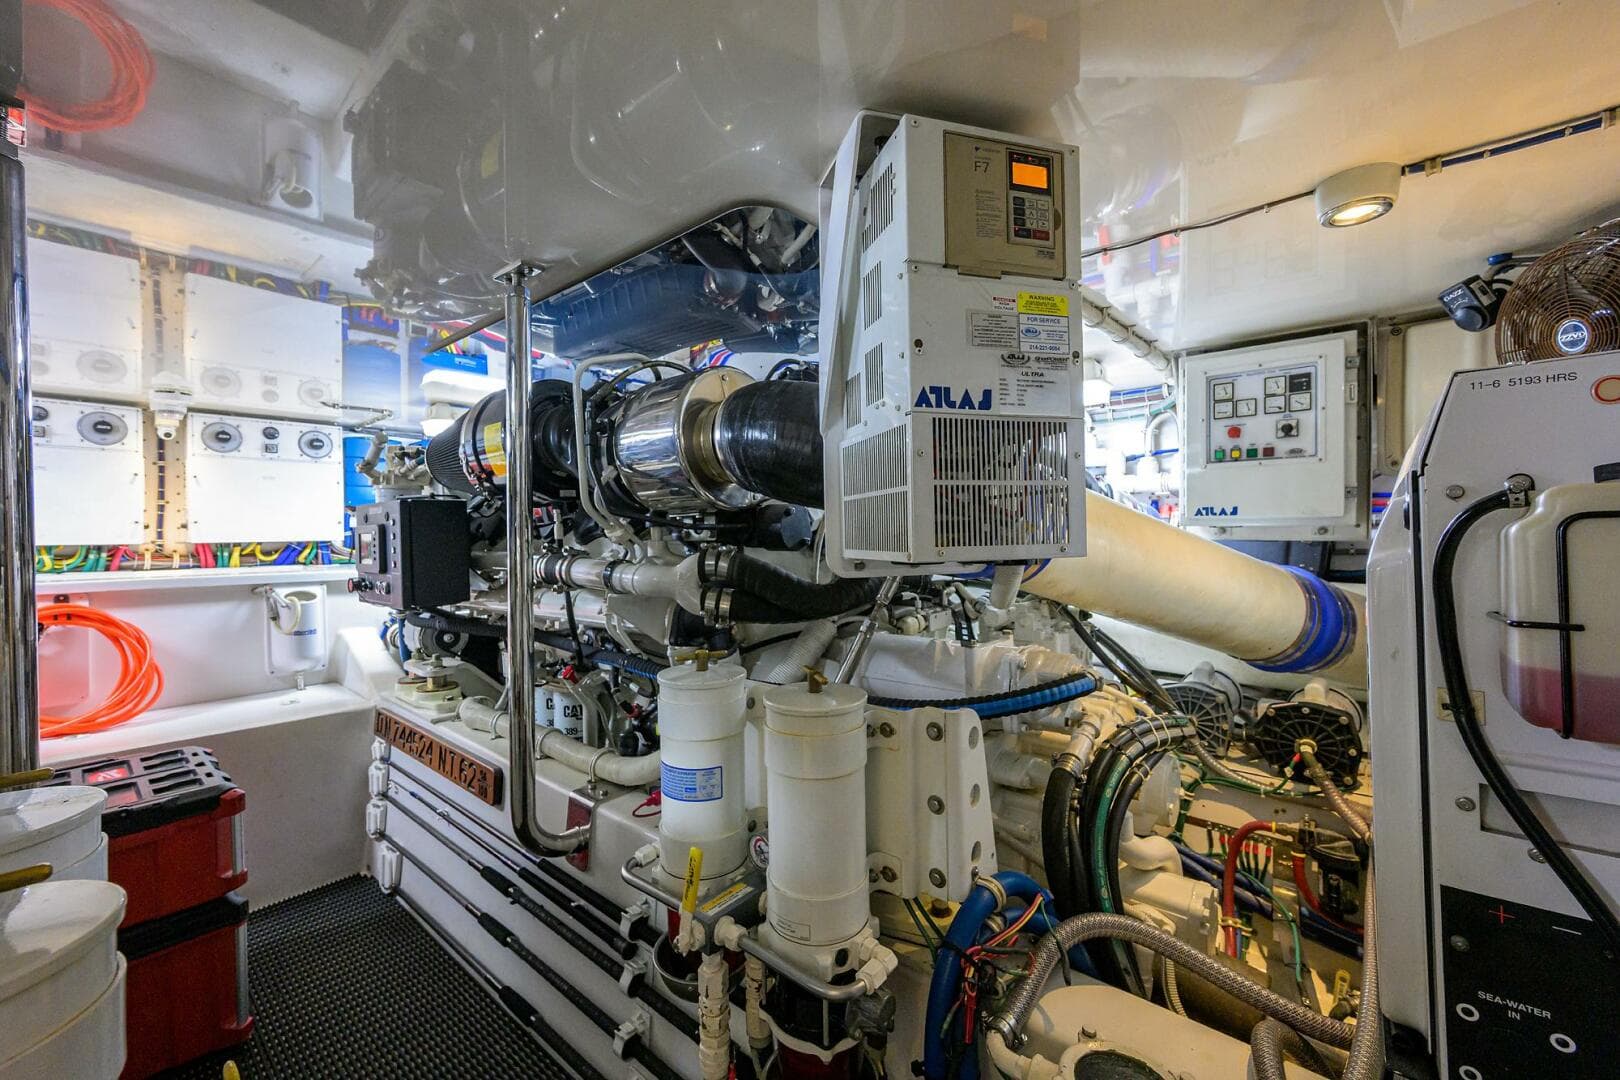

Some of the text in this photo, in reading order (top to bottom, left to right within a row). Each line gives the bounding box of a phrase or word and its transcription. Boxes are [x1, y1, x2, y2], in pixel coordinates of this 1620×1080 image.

[974, 161, 990, 173] F7
[1508, 375, 1542, 387] 5193
[1546, 372, 1578, 383] HRS
[1477, 990, 1552, 1019] SEA-WATER
[1508, 1010, 1521, 1020] IN
